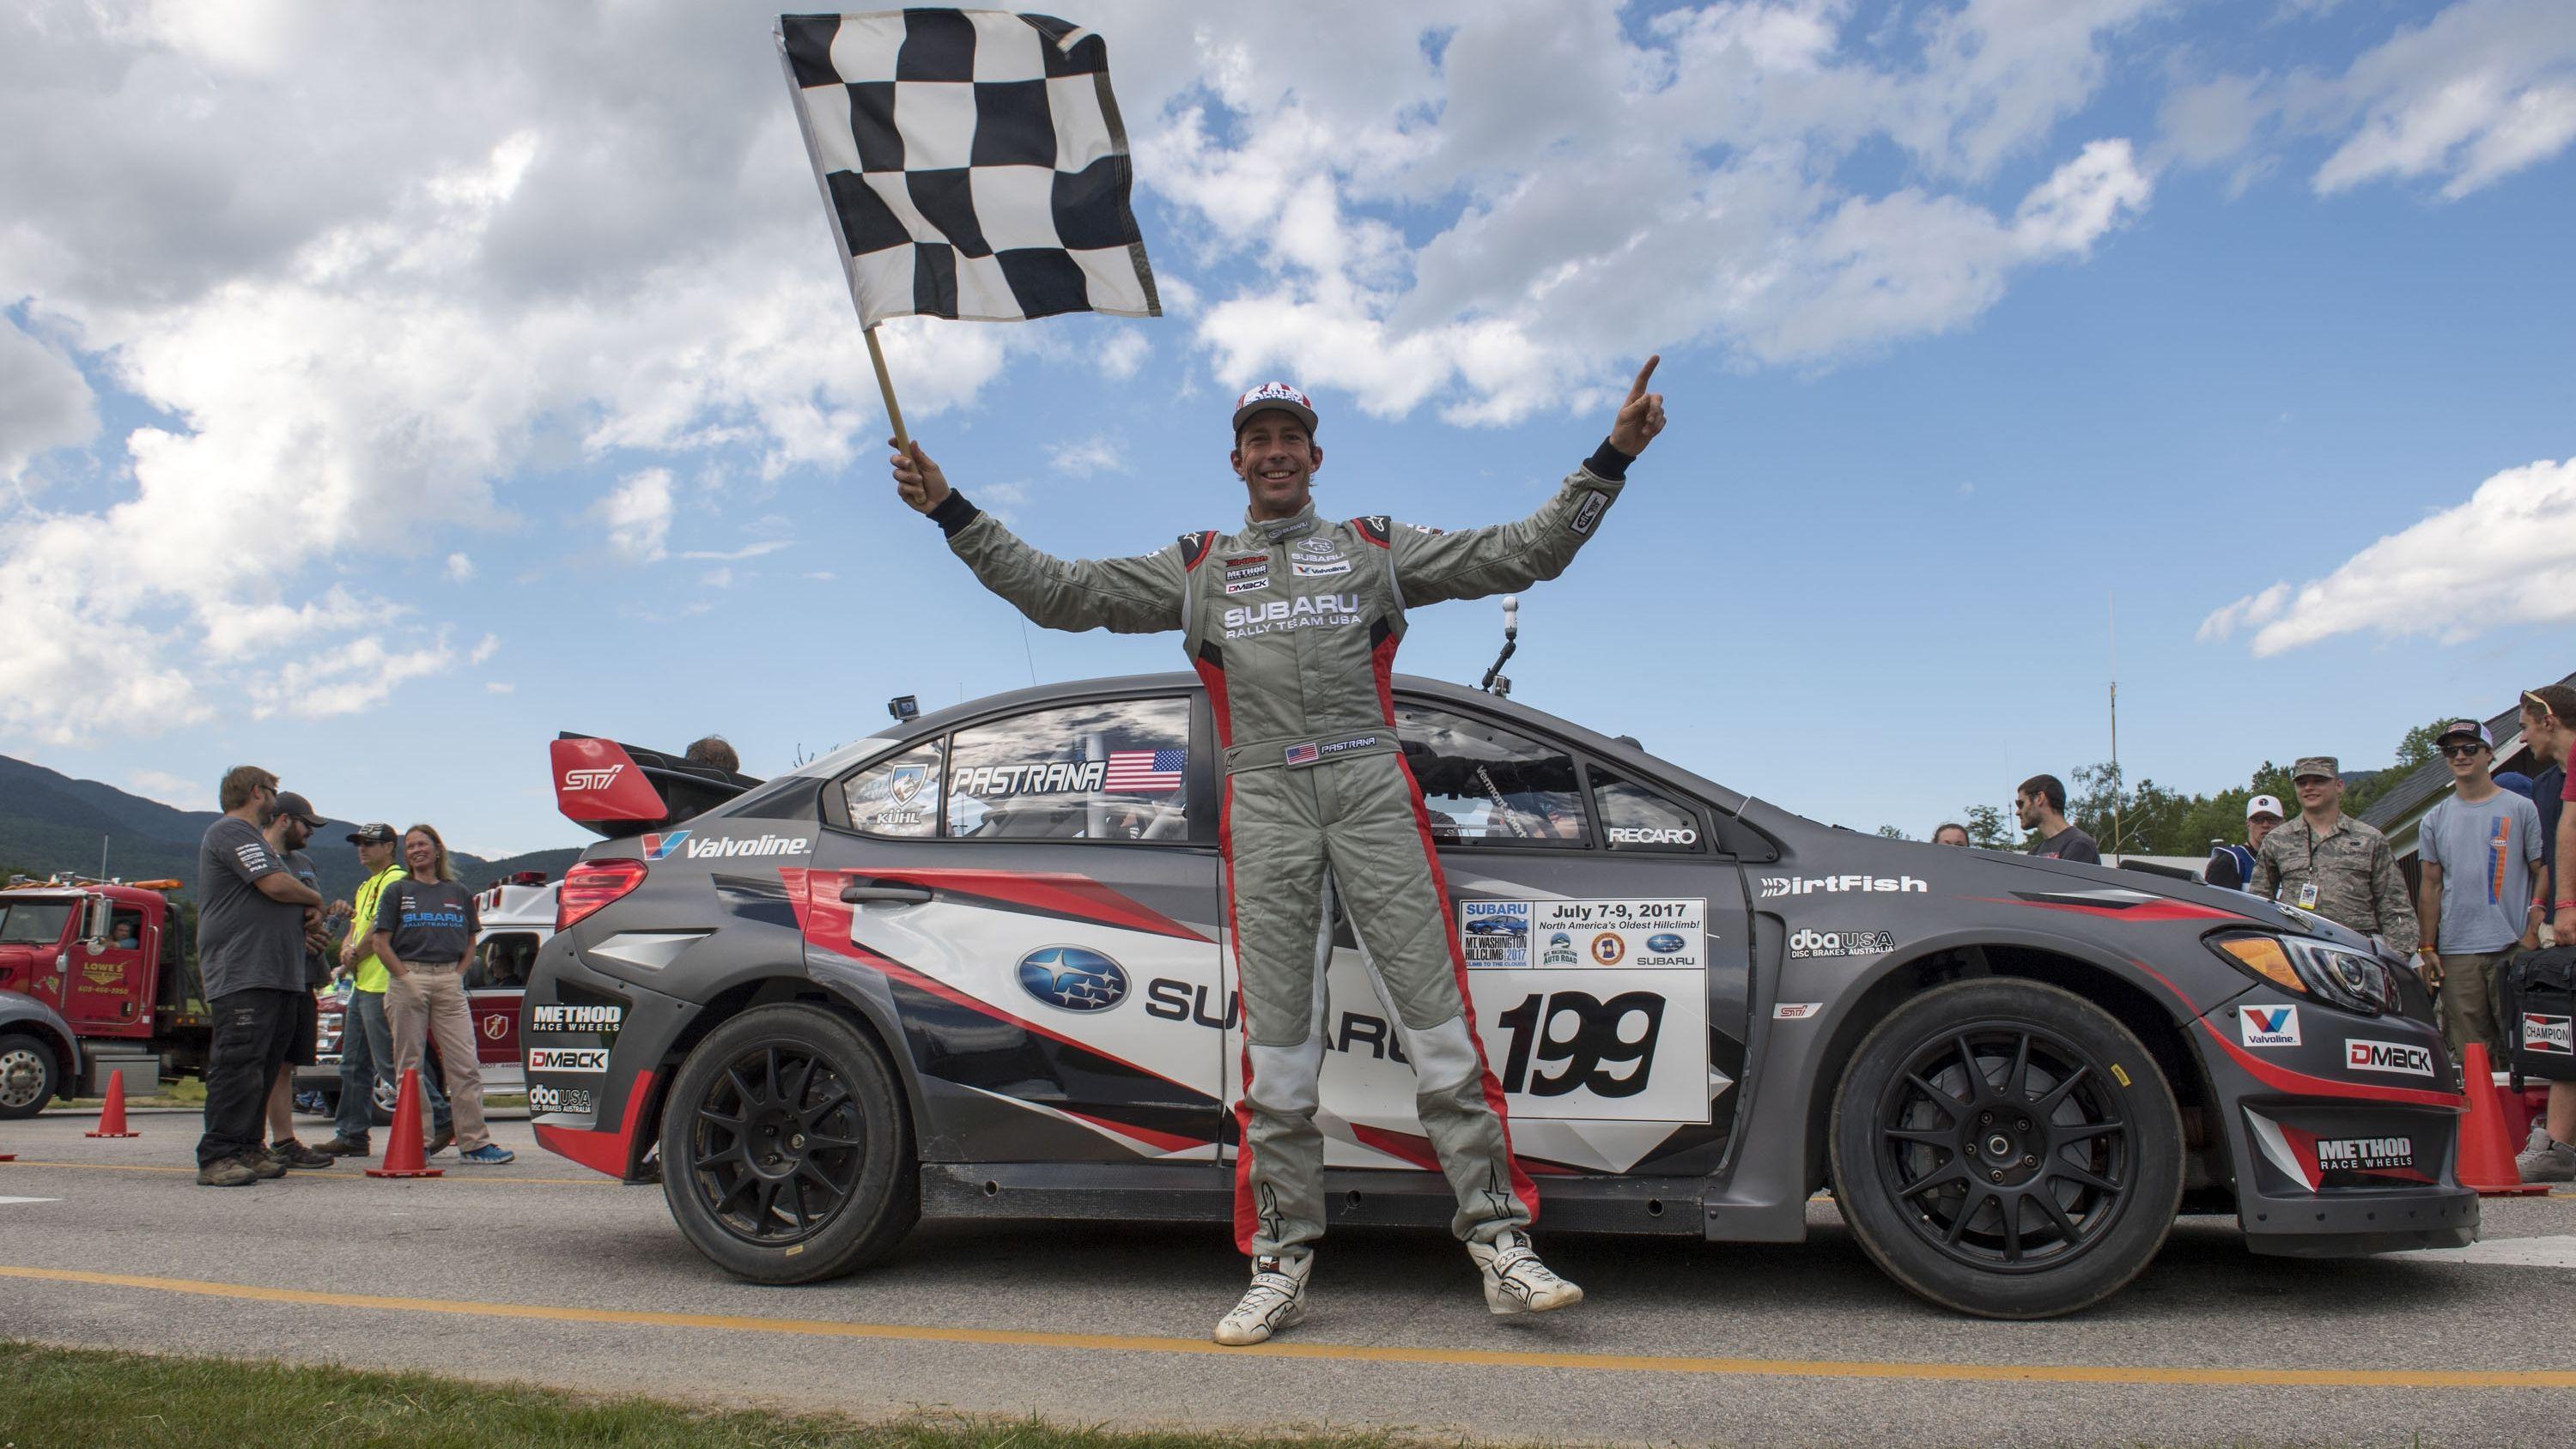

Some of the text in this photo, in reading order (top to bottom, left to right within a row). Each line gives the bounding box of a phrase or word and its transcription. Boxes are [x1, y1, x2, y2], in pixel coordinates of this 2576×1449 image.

[1291, 552, 1347, 562] SUBARU
[1226, 565, 1267, 578] METHOD
[1311, 566, 1346, 574] Valvoline
[1224, 593, 1358, 628] SUBARU
[1225, 615, 1363, 639] RALLY TEAM USA
[1321, 737, 1376, 754] PASTRANA
[949, 761, 1107, 797] PASTRANA
[1477, 764, 1509, 809] Vermont
[876, 808, 921, 824] KÜHL
[1608, 827, 1698, 845] RECARO
[687, 834, 808, 858] Valvoline
[1760, 875, 1928, 898] DirtFish
[1466, 903, 1528, 915] SUBARU
[1552, 903, 1687, 921] July 7-9, 2017
[403, 912, 464, 923] SUBARU
[1539, 920, 1700, 930] North America's Oldest Hillclimb!
[1478, 936, 1528, 949] WASHINGTON
[1465, 949, 1528, 961] HILLCLIMB 2017
[1791, 945, 1895, 958] DISC BRAKES AUSTRALIA
[1543, 955, 1578, 966] AUTO ROAD
[1637, 957, 1695, 966] SUBARU
[533, 1005, 622, 1023] METHOD
[532, 1022, 620, 1032] RACE WHEELS
[2526, 1025, 2569, 1041] CHAMPION
[1497, 990, 1667, 1099] 199
[2248, 1035, 2294, 1044] Valvoline
[542, 1104, 562, 1113] BRAKES
[562, 1105, 592, 1113] AUSTRALIA
[2317, 1137, 2412, 1160] METHOD
[2320, 1157, 2413, 1170] RACE WHEELS
